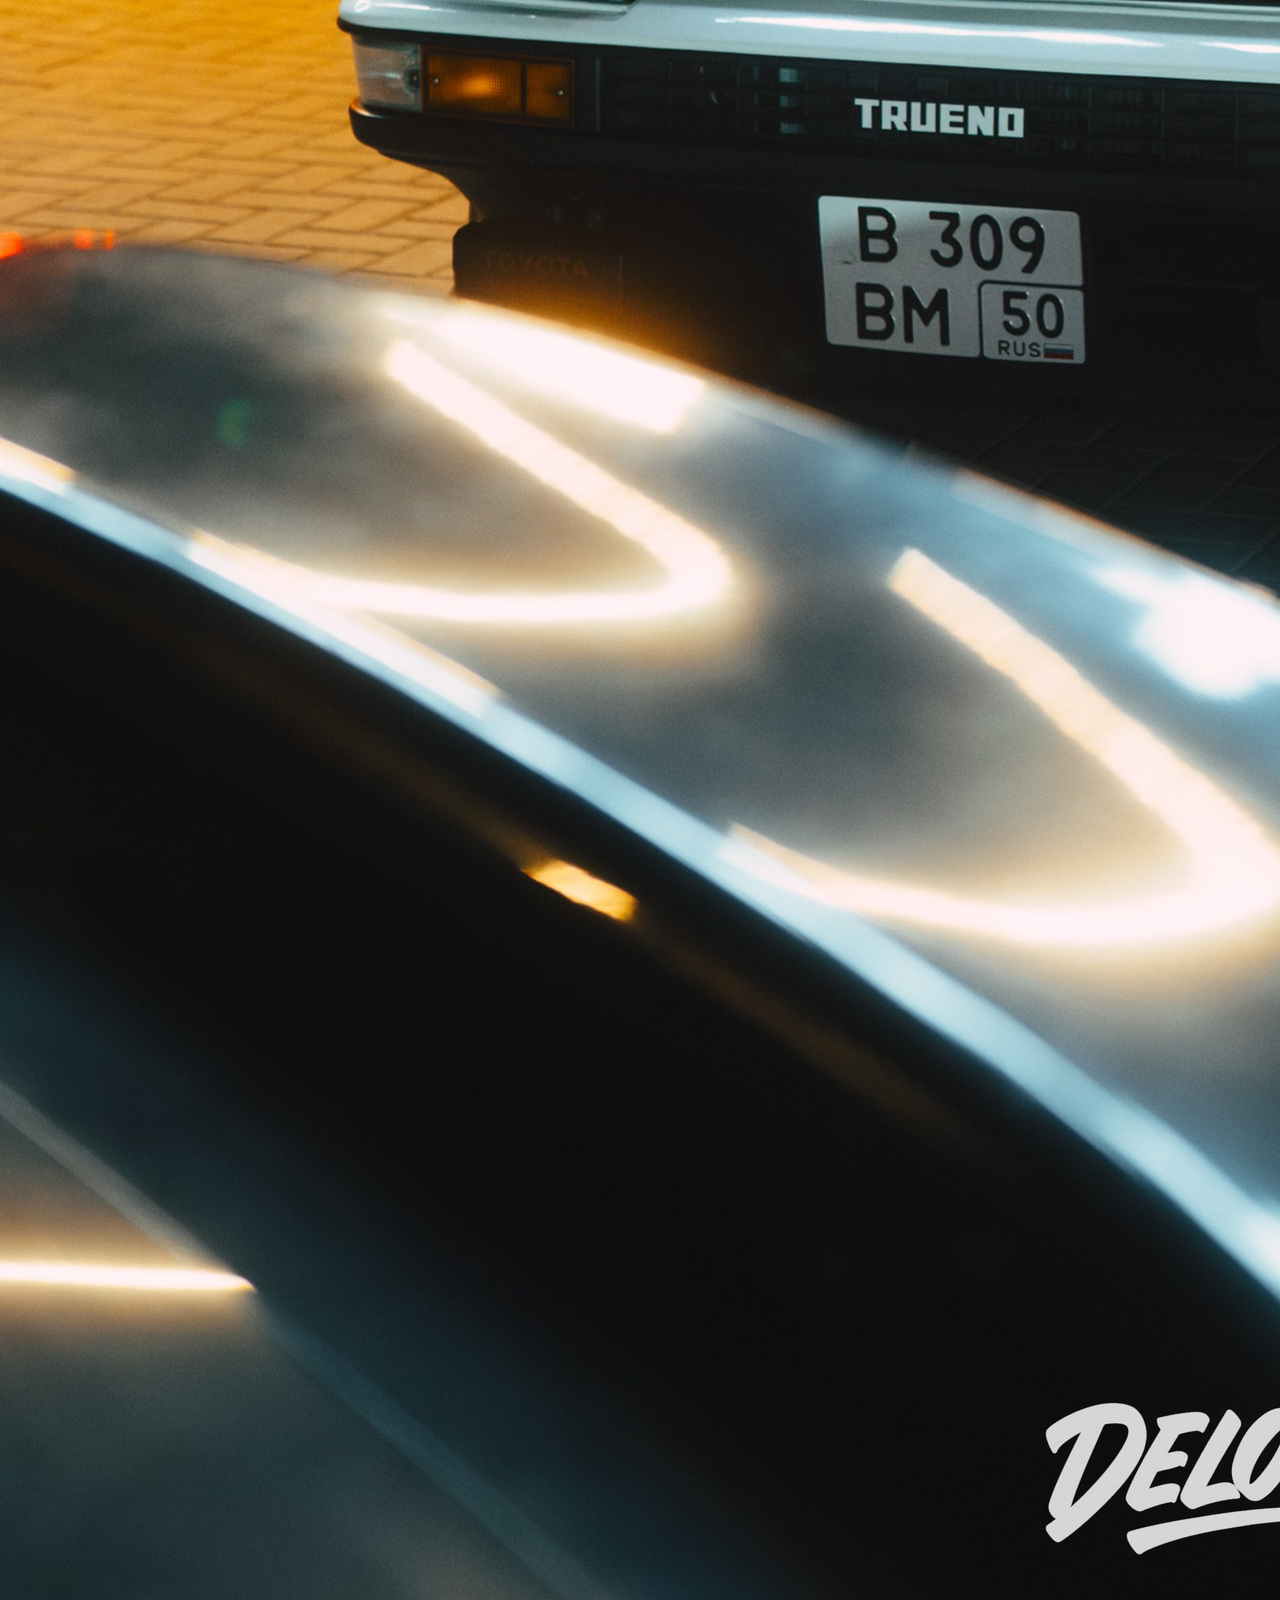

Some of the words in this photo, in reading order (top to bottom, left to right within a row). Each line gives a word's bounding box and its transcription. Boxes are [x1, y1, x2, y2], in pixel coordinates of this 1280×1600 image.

[854, 98, 1025, 138] TRUENO
[858, 206, 898, 263] B
[929, 211, 1045, 274] 309
[855, 282, 950, 346] BM
[1002, 291, 1064, 338] 50
[998, 340, 1041, 357] RUS
